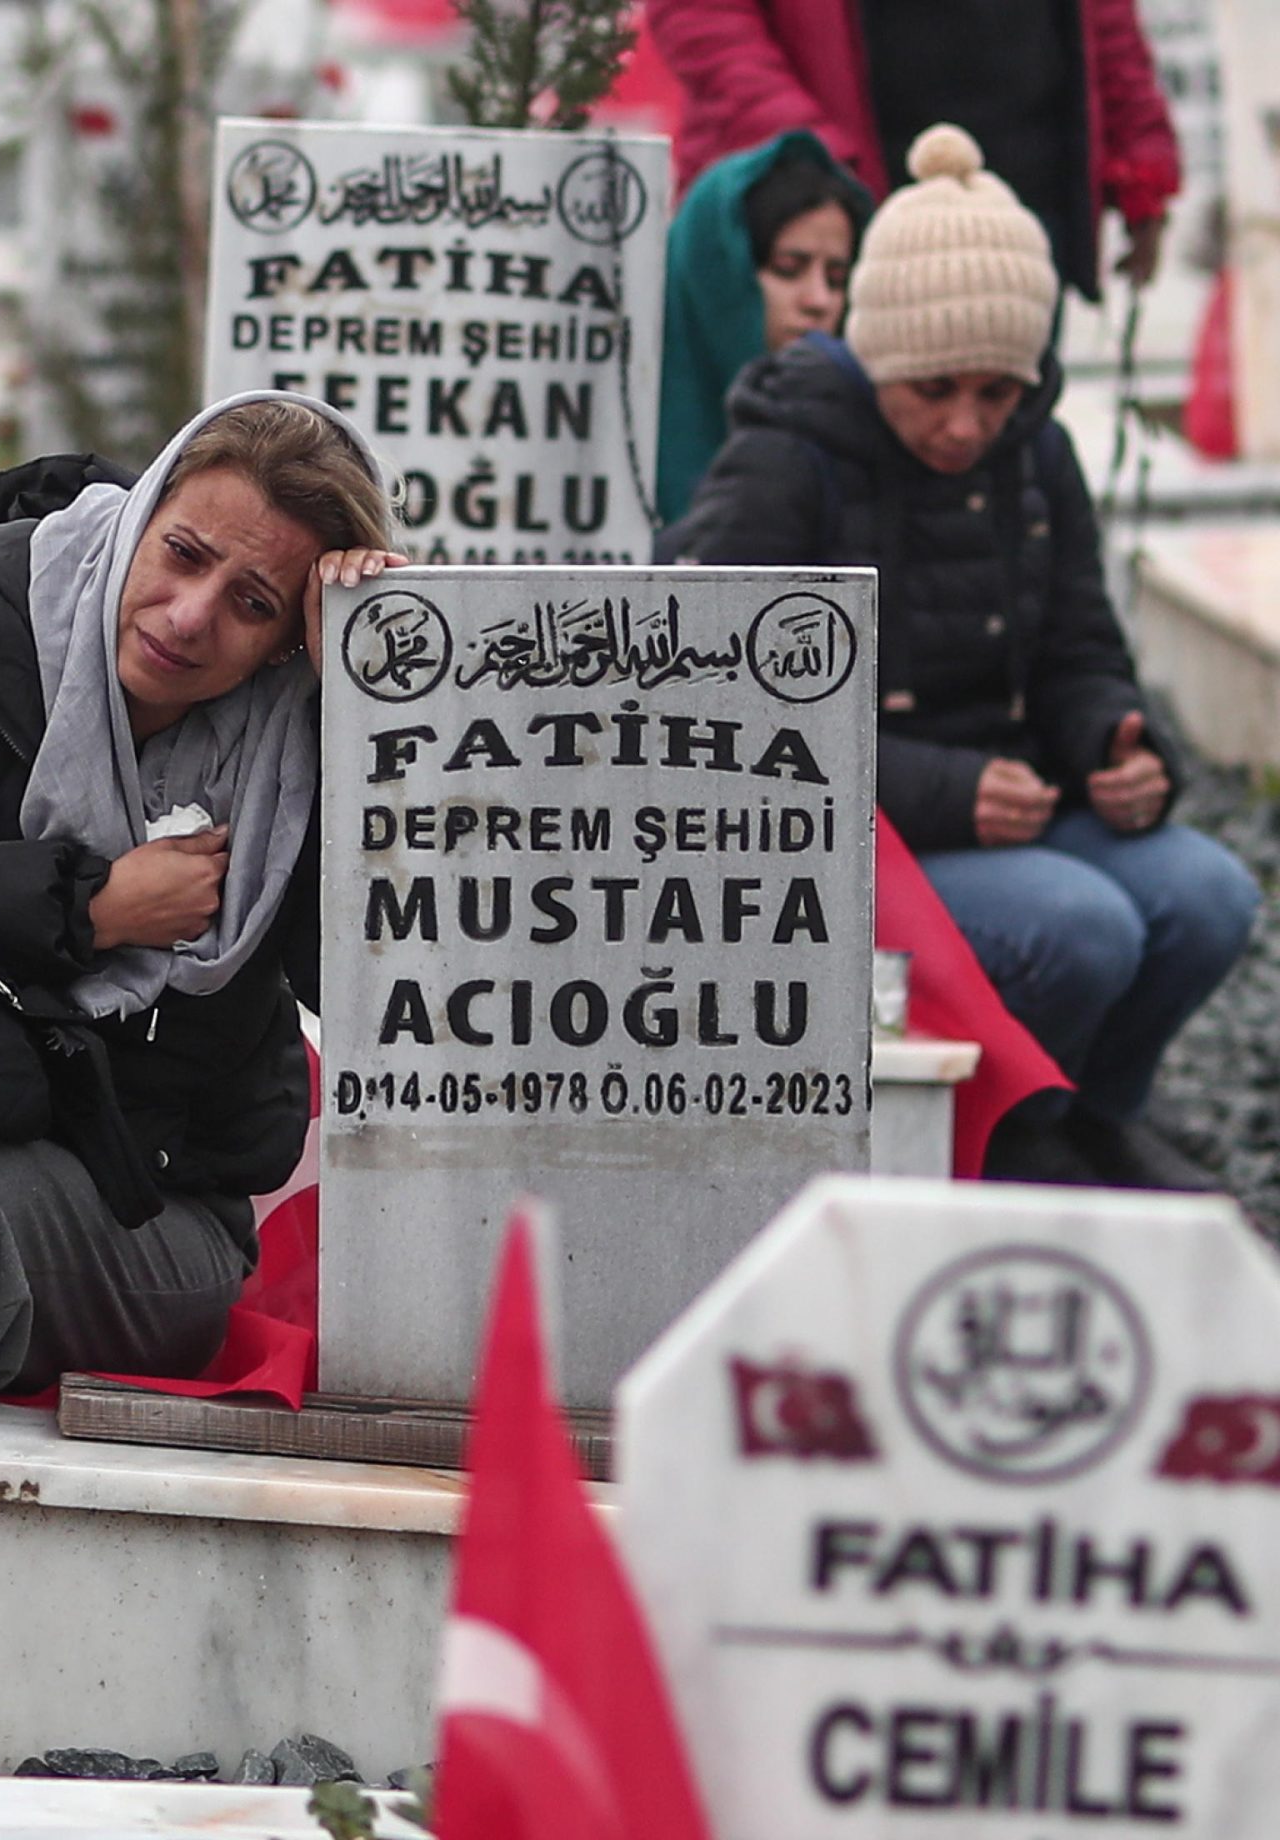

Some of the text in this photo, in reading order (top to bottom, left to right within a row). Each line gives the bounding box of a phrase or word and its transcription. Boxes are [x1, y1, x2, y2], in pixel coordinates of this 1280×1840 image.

[246, 240, 618, 312] FATİHA
[232, 314, 442, 358] DEPREM
[272, 373, 593, 441] FEKAN
[392, 454, 608, 534] OĞLU
[367, 699, 830, 786] FATİHA
[362, 797, 834, 863] DEPREM ŞEHİDİ
[364, 876, 830, 944] MUSTAFA
[378, 966, 809, 1048] ACIOĞLU
[809, 1512, 1254, 1618] FATİHA
[807, 1692, 1187, 1824] CEMİLE
